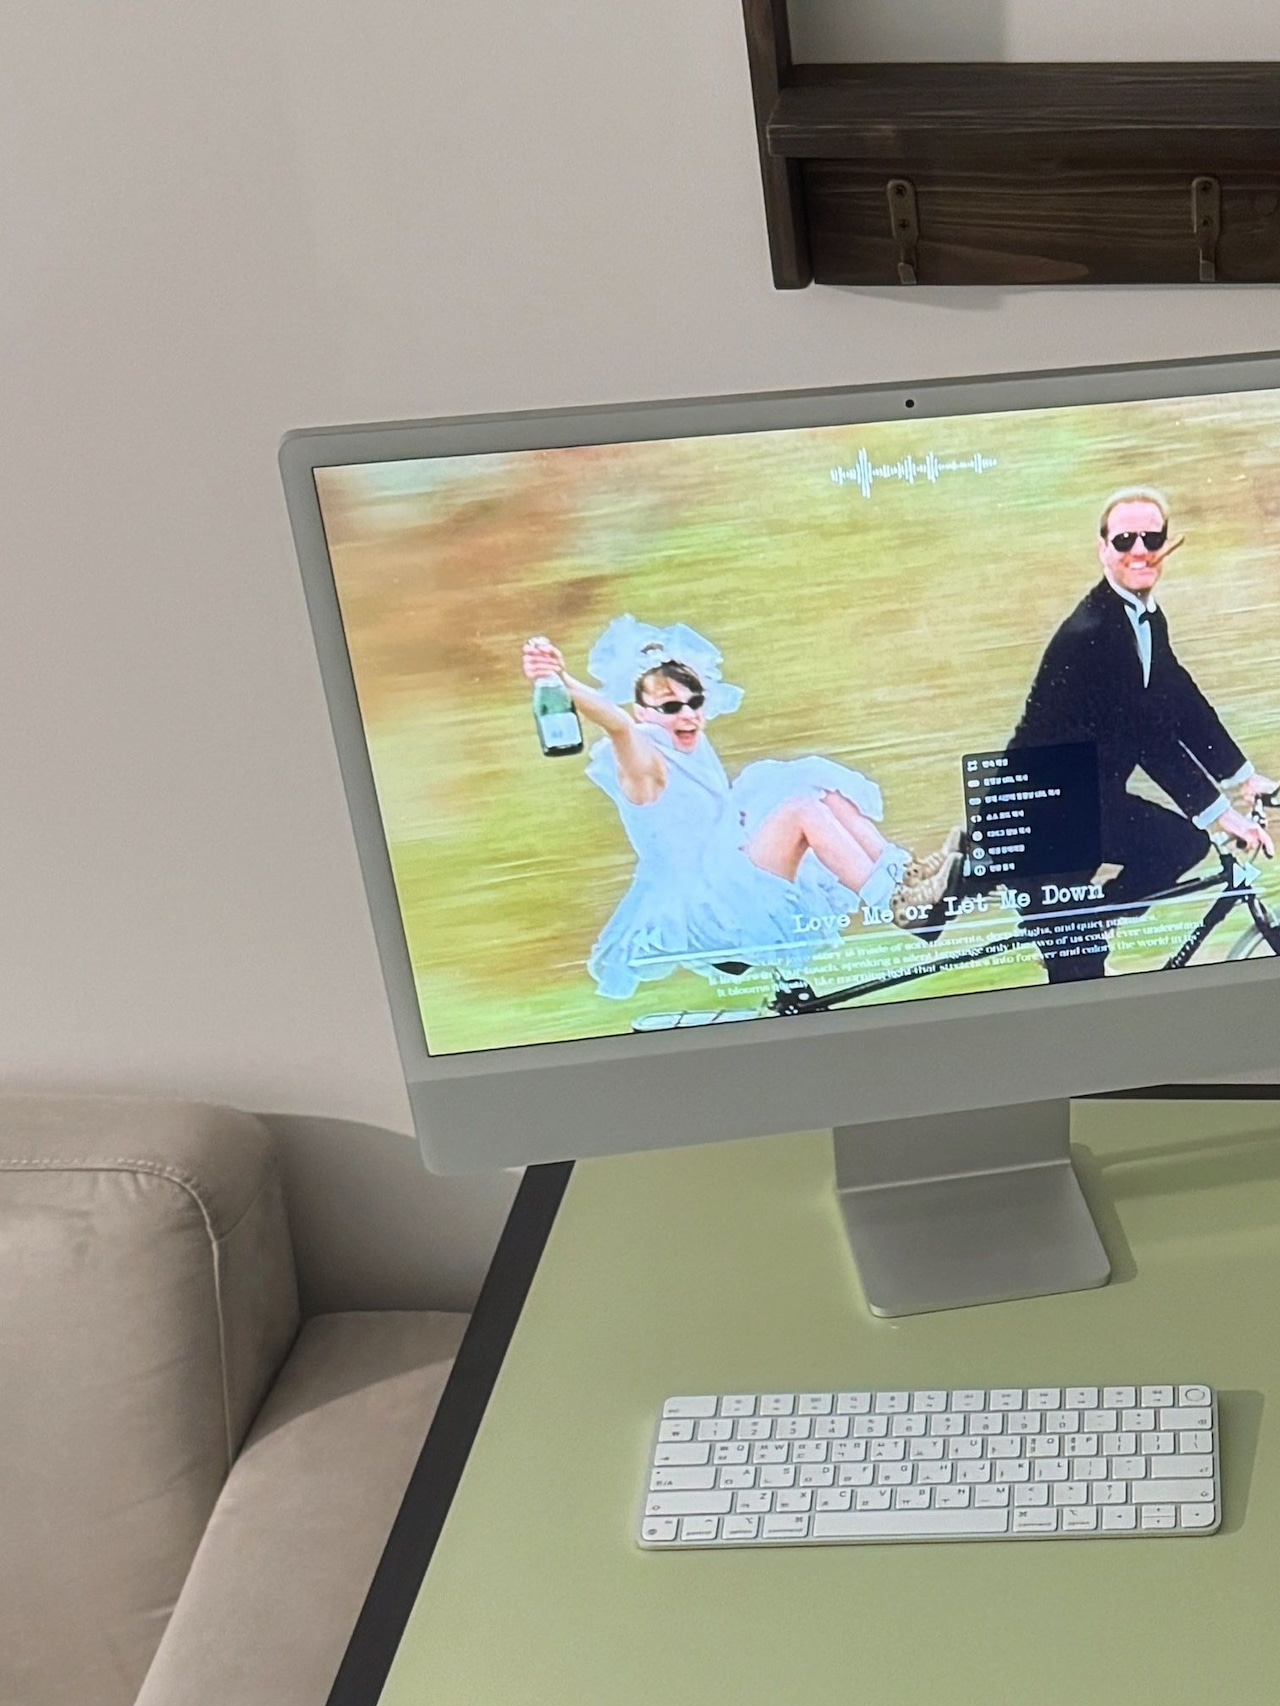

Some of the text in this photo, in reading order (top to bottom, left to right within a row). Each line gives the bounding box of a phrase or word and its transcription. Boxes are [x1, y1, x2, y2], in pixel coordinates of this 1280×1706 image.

[793, 883, 1105, 934] Love Me or Let Me Down
[1053, 921, 1075, 933] and
[1076, 918, 1103, 931] quiet
[914, 963, 937, 975] that
[991, 954, 1015, 966] into
[1059, 945, 1081, 958] and
[1117, 939, 1138, 951] the
[1139, 934, 1170, 948] world
[985, 943, 1009, 954] only
[1055, 935, 1068, 946] of
[1070, 932, 1084, 943] us
[1084, 926, 1115, 941] could
